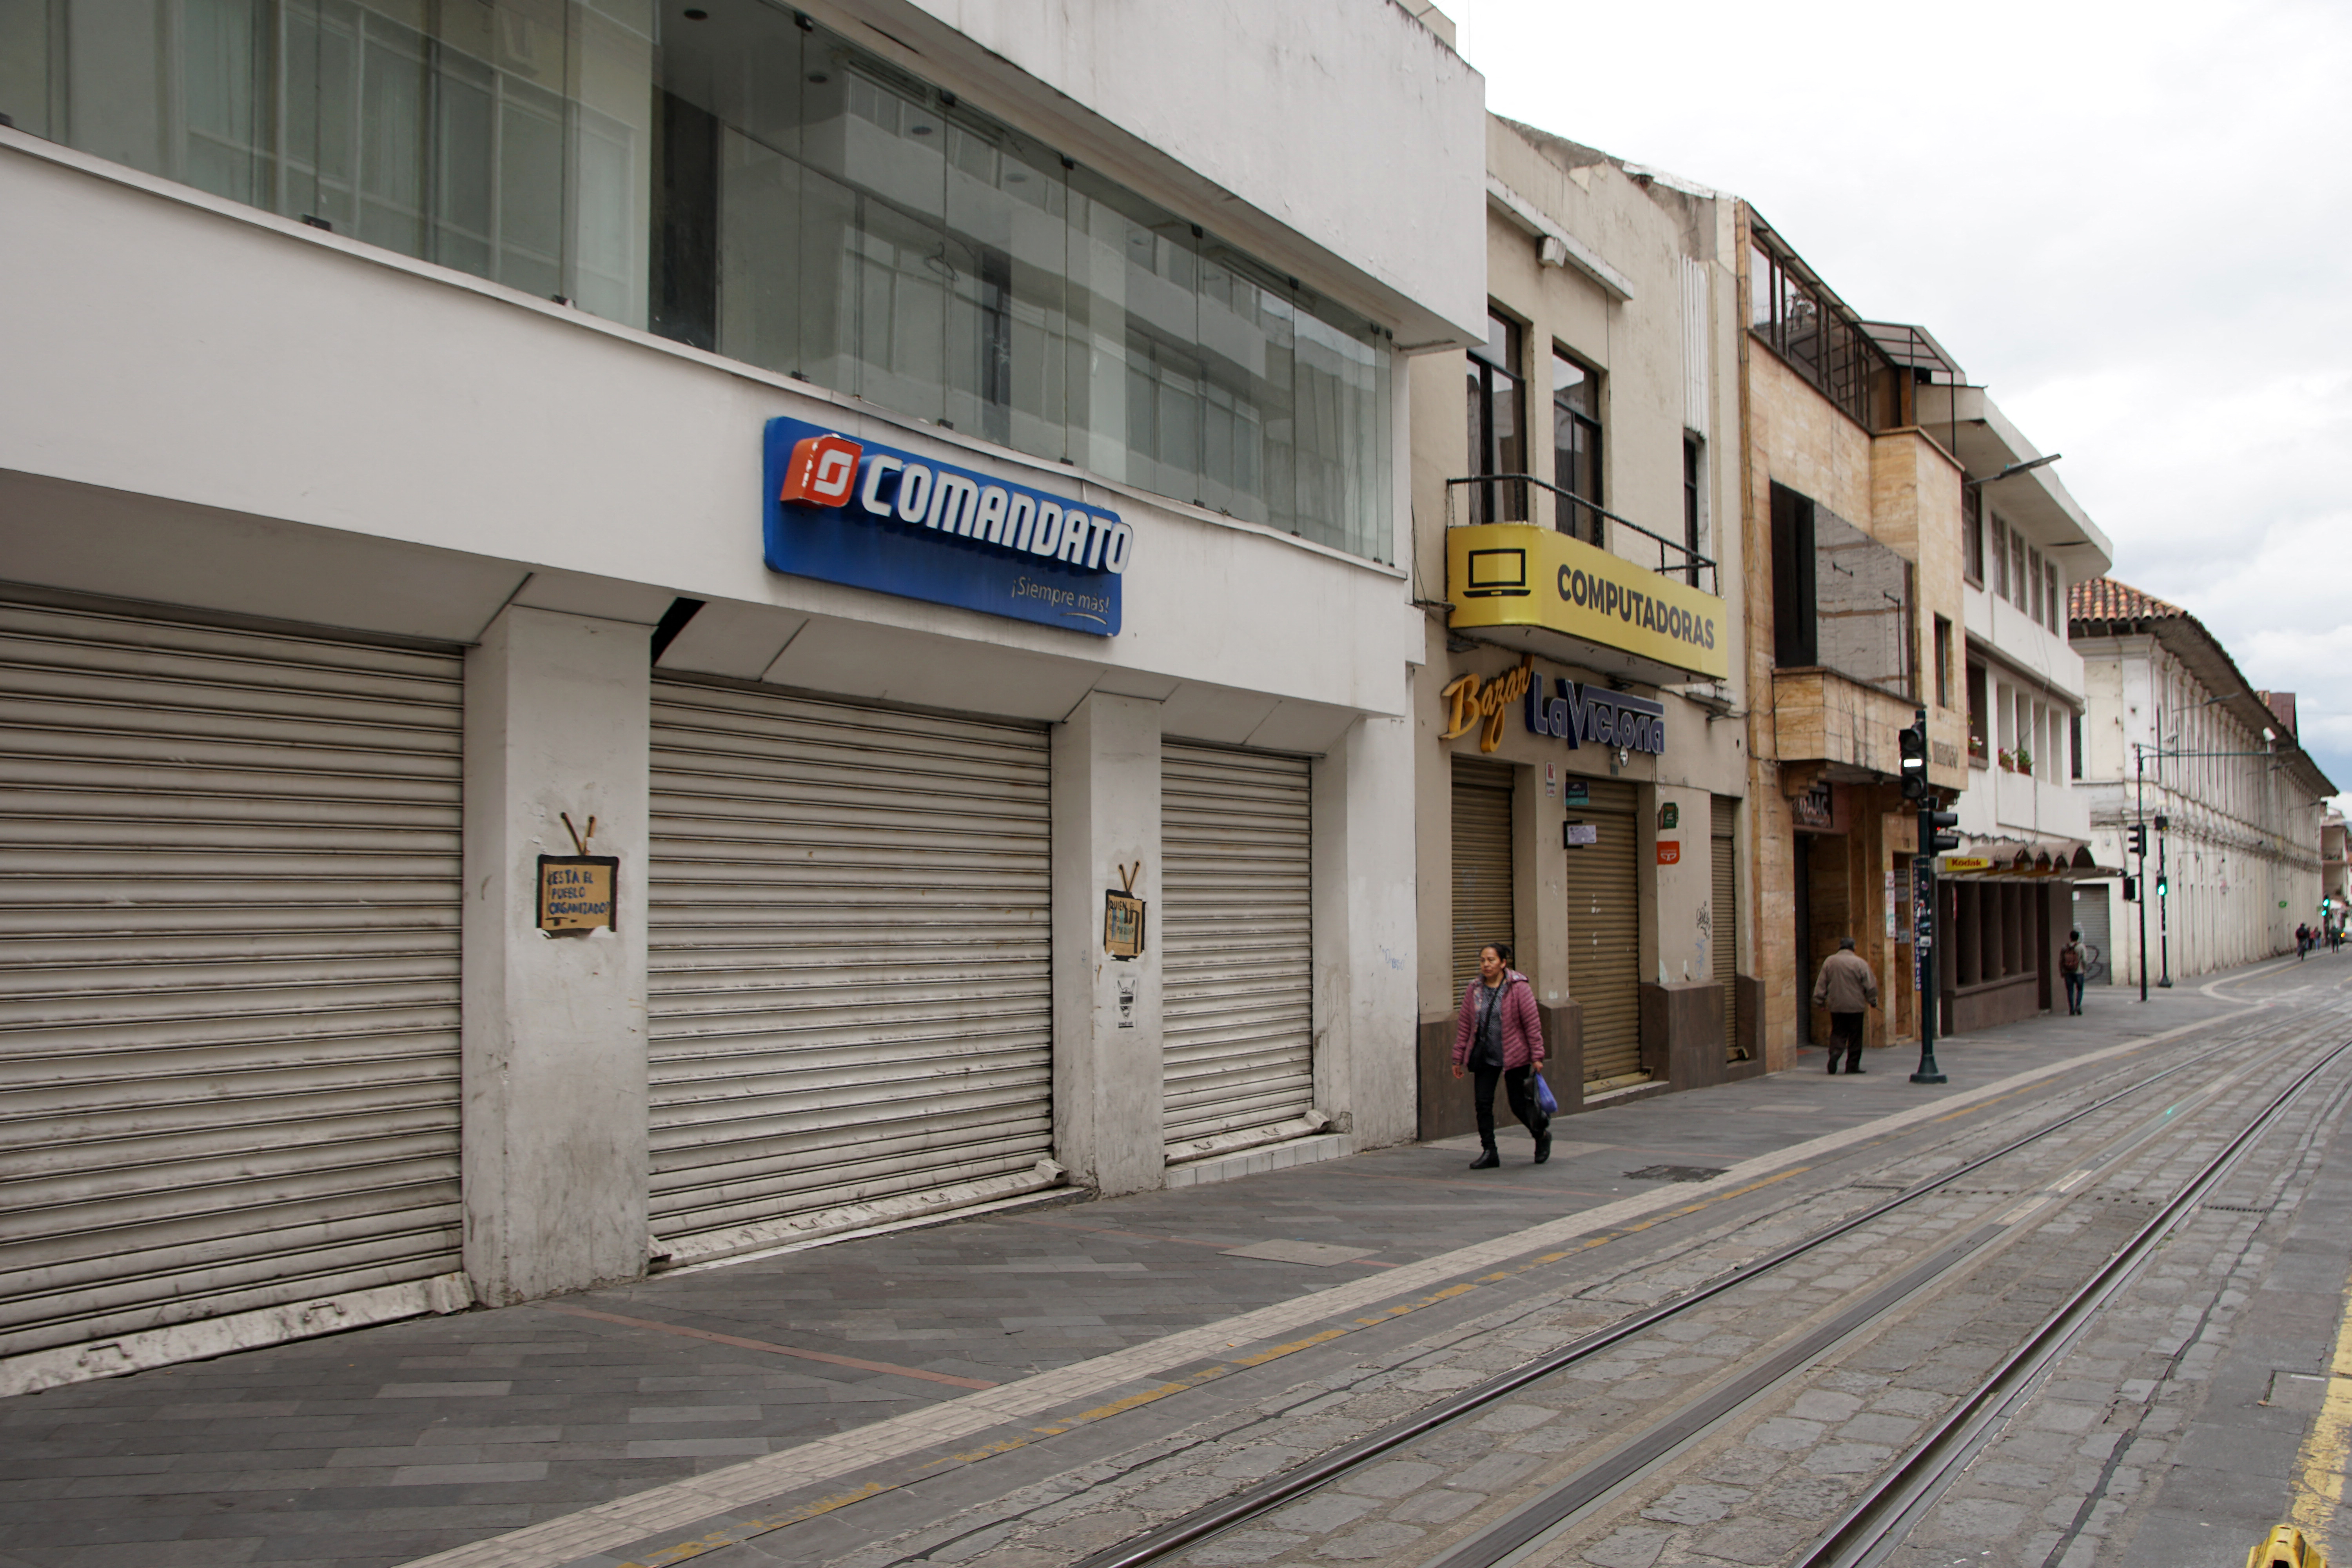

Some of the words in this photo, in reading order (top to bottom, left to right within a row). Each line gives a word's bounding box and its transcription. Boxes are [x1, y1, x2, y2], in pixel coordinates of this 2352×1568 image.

[862, 454, 1133, 574] COMANDATO
[1011, 576, 1074, 607] ¡Siempre
[1078, 592, 1110, 613] más!
[1557, 564, 1715, 650] COMPUTADORAS
[1438, 653, 1534, 753] Bazar
[584, 871, 593, 884] EL
[1951, 858, 1982, 867] Kodak
[552, 886, 586, 899] PUEBLO
